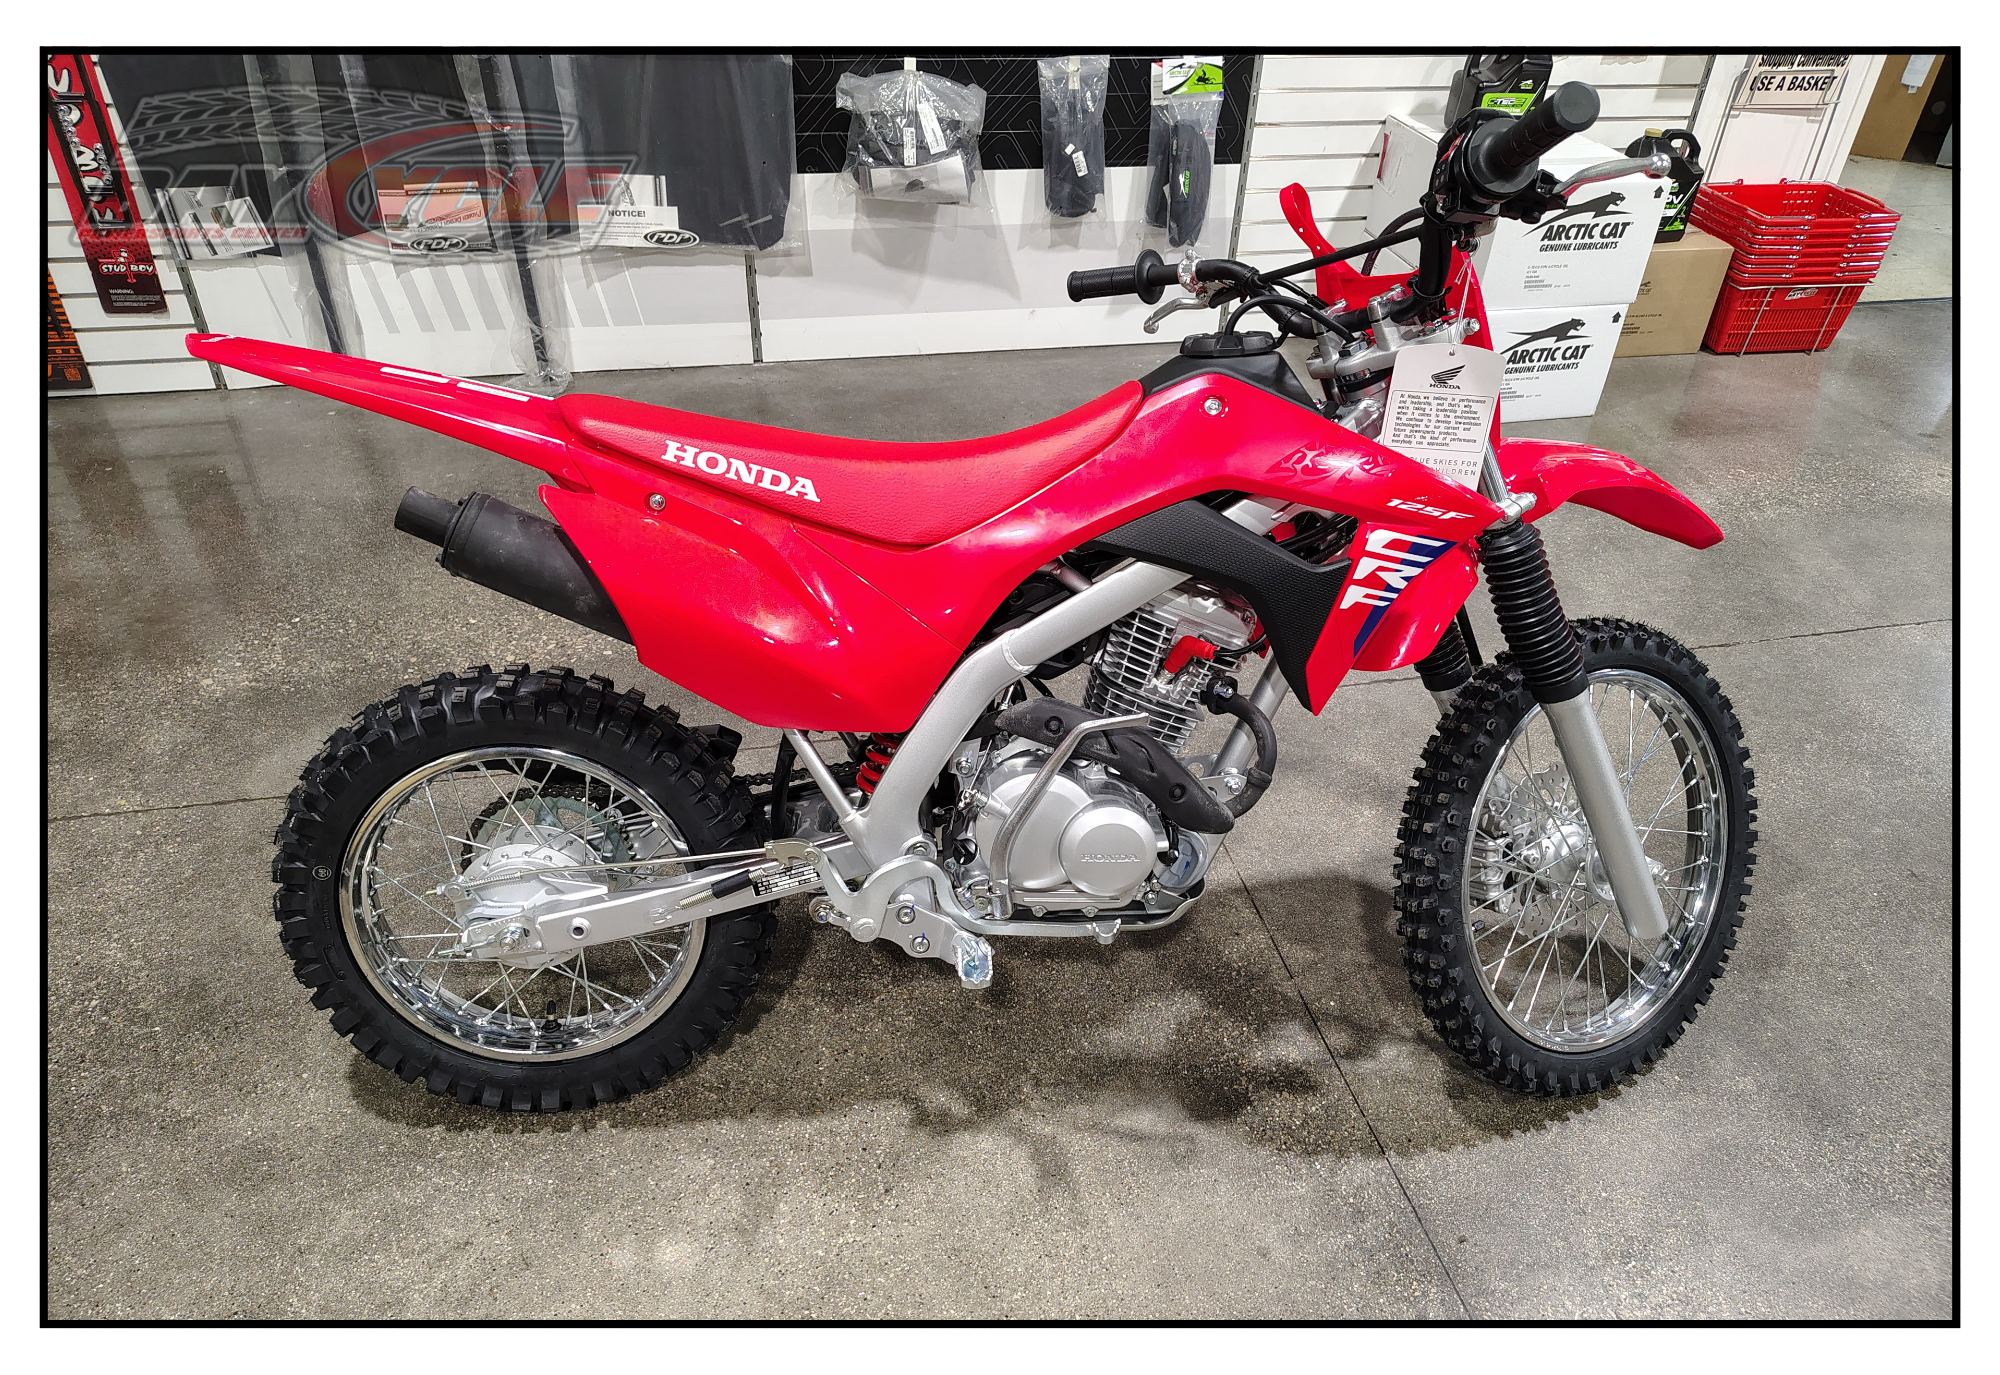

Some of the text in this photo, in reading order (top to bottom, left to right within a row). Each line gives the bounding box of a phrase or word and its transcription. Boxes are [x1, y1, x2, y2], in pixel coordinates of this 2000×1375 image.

[1775, 76, 1786, 91] A
[1787, 75, 1838, 91] BASKET
[608, 209, 646, 217] NOTICE!
[1540, 222, 1631, 241] ARCTIC CAT
[1539, 241, 1619, 252] GENUINE LUBRICANTS
[101, 264, 155, 273] STUD BOY
[1507, 344, 1590, 365] ARCTIC CAT
[1505, 362, 1580, 374] GENUINE LUBRICANTS
[1433, 458, 1458, 466] SKIES
[660, 439, 821, 503] HONDA
[1385, 498, 1476, 520] 125F
[1340, 529, 1446, 610] CRF
[1080, 853, 1141, 863] HONDA
